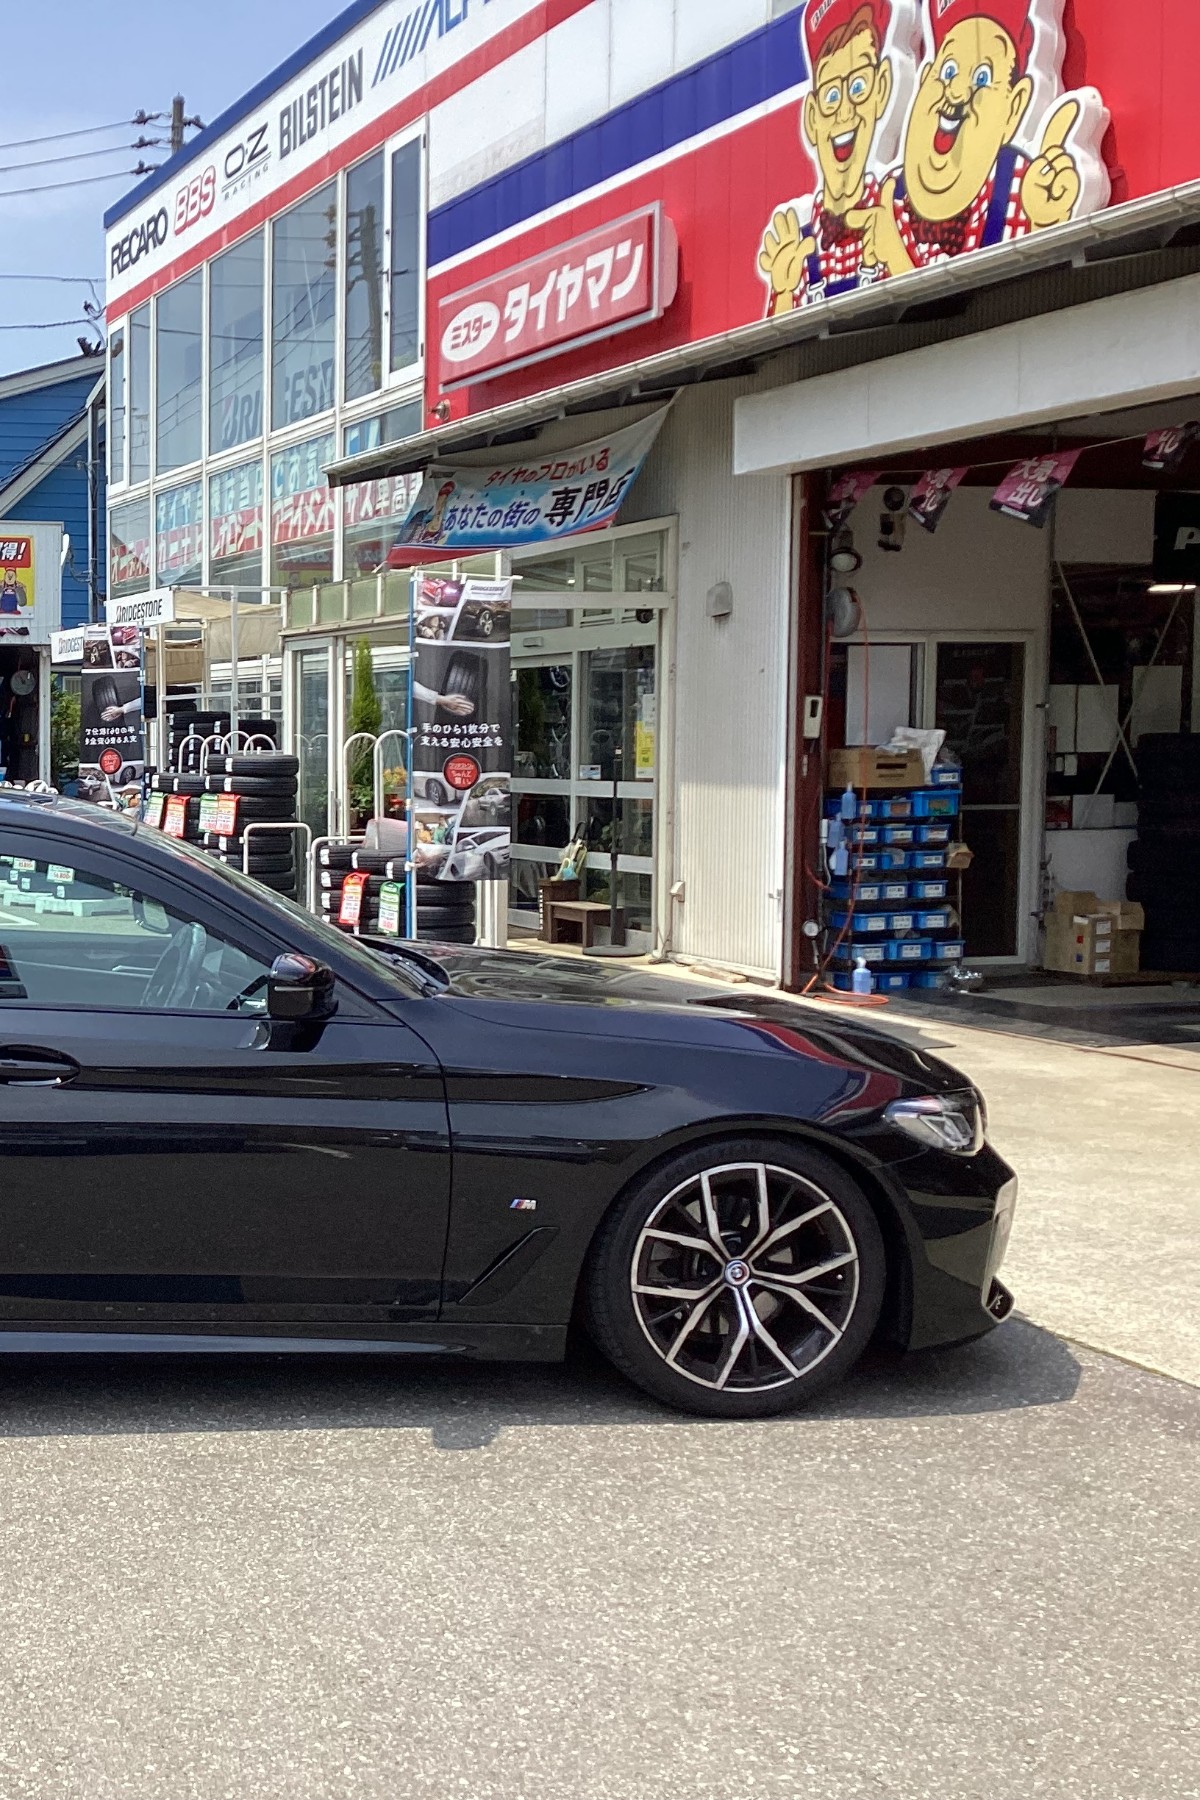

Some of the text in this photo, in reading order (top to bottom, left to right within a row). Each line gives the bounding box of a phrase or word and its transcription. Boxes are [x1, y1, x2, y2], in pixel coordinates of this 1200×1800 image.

[279, 47, 363, 160] BILSTEIN
[173, 165, 216, 237] BBS
[224, 163, 269, 201] RACING
[110, 207, 169, 280] RECARO
[503, 239, 644, 344] タイヤマン
[451, 314, 492, 348] ミスター
[484, 447, 611, 488] タイヤのプロがいる
[1007, 481, 1043, 507] 出し
[116, 599, 162, 623] BRIDGESTONE
[420, 735, 503, 748] 支える安心安全を
[422, 722, 501, 735] 手のひら1枚分で
